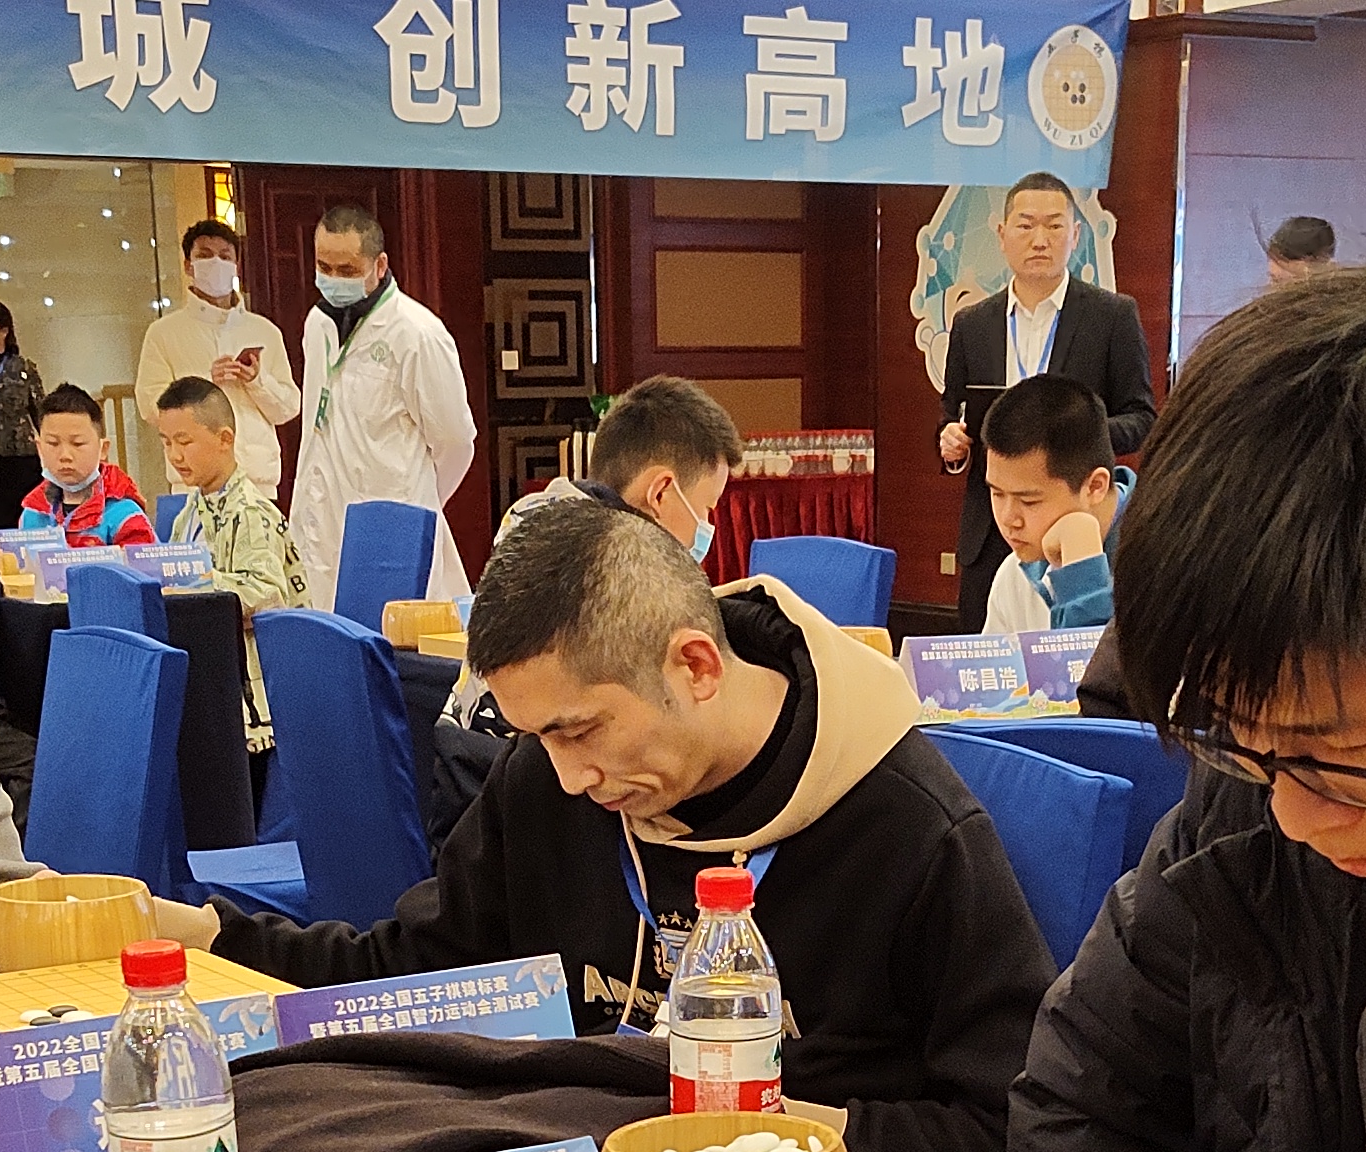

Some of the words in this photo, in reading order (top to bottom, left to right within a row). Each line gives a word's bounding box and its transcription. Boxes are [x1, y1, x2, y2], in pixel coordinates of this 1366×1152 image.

[373, 0, 1006, 148] 创新高地
[958, 666, 1019, 693] 陈昌浩
[309, 991, 540, 1039] 暨第五届全国智力运动会测试赛
[335, 975, 510, 1016] 2022全国五子棋锦标赛
